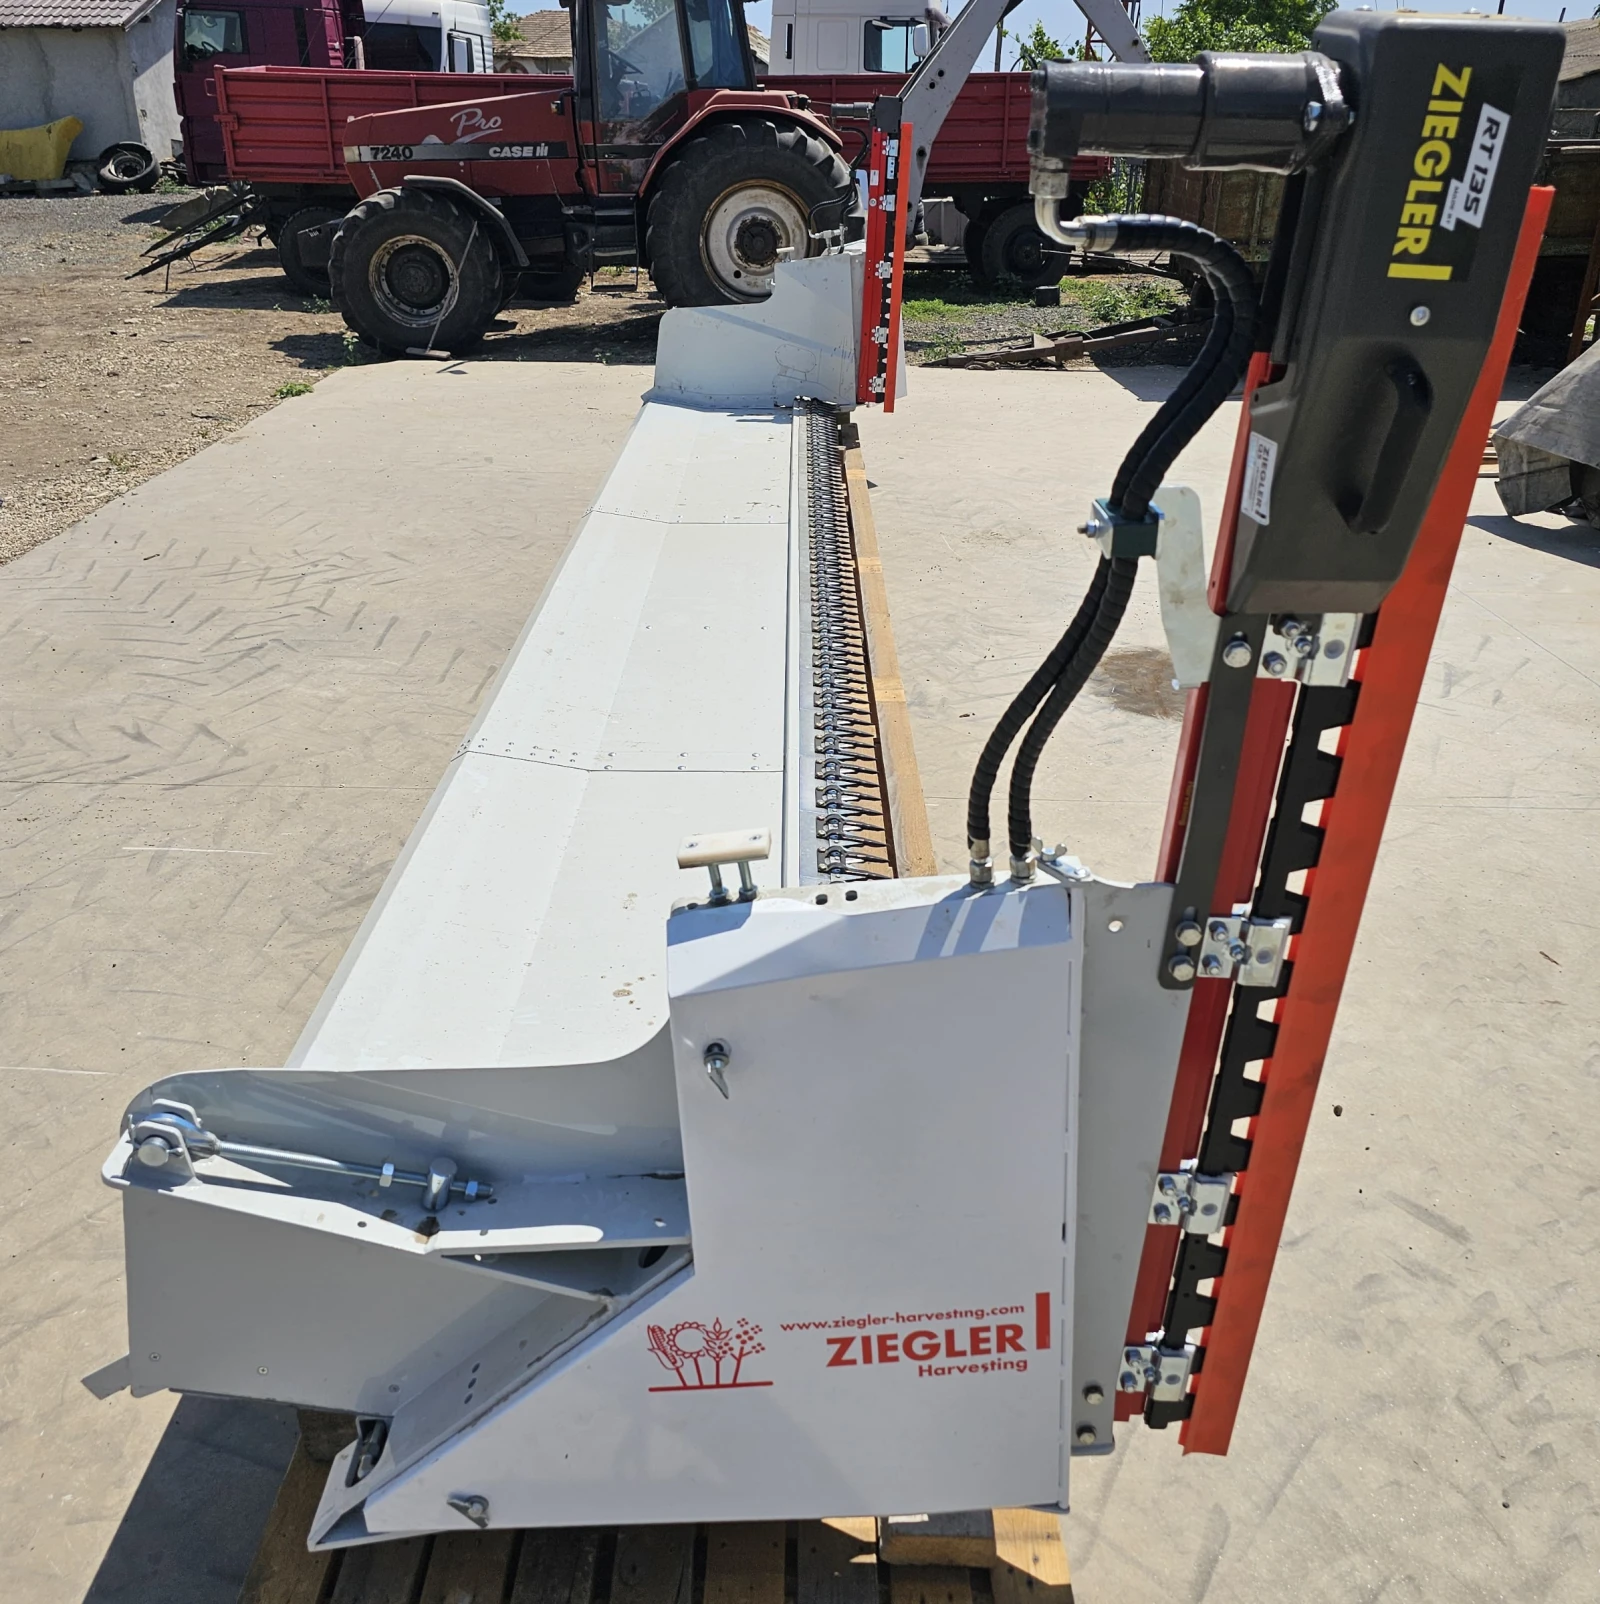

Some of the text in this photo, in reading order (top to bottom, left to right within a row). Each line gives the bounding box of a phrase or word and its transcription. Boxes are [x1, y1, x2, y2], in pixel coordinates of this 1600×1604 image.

[450, 108, 502, 137] Pro
[370, 146, 414, 161] 7240
[489, 146, 534, 158] CASE
[1478, 116, 1501, 162] RT
[1392, 63, 1472, 256] ZIEGLER
[1255, 447, 1270, 508] ZIEGLER
[780, 1303, 1025, 1332] www.ziegler-harvesting.com
[825, 1323, 1026, 1368] ZIEGLER
[918, 1356, 1028, 1378] Harvesting
